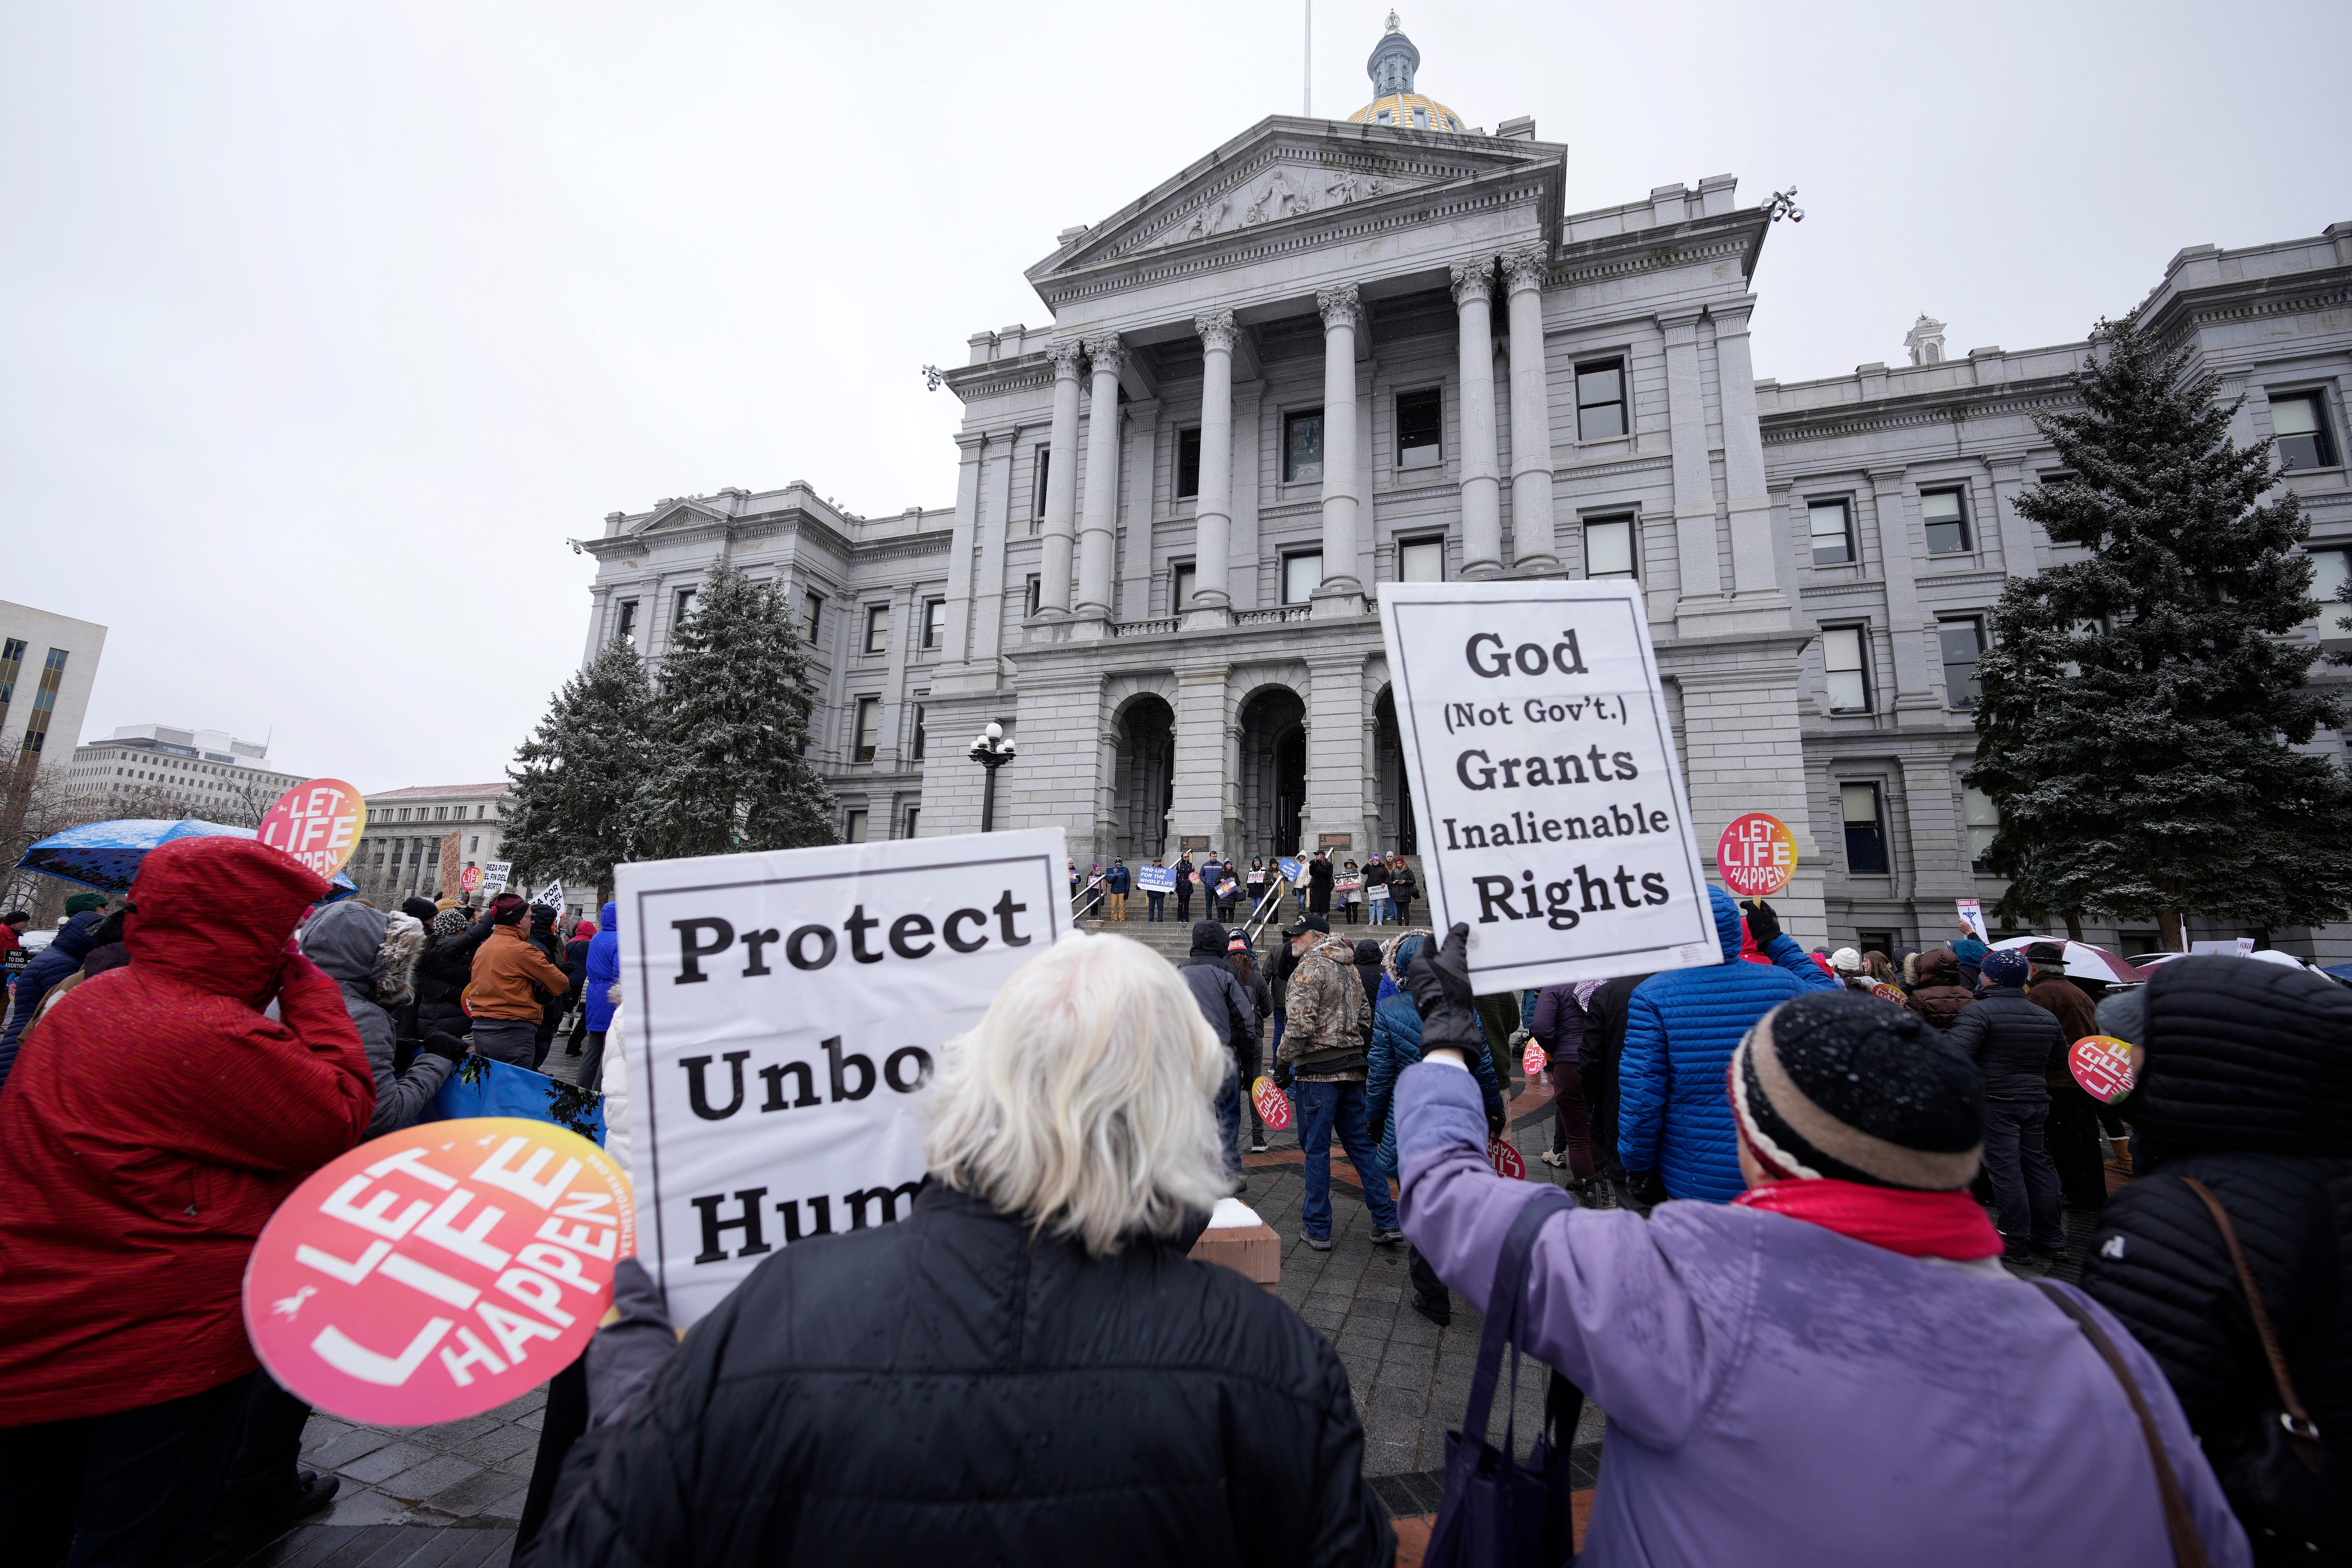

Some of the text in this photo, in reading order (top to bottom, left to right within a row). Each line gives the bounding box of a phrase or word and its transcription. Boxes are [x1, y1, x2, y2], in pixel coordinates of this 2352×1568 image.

[1465, 629, 1589, 678] God
[1444, 695, 1627, 734] (Not Gov't.)
[1457, 745, 1638, 791] Grants
[289, 787, 345, 819] LET
[264, 816, 357, 852] LIFE
[1443, 803, 1670, 851] Inalienable
[1739, 820, 1775, 842] LET
[1283, 864, 1296, 873] Abortions
[1724, 842, 1791, 866] LIFE
[544, 884, 559, 900] POR
[1730, 866, 1785, 890] HAPPEN
[1766, 863, 1795, 893] SAVETHESTORKS.ORG
[550, 892, 562, 907] DEL
[1472, 864, 1669, 930] Rights
[671, 890, 1032, 985] Protect
[1876, 987, 1888, 1001] ET
[1537, 1047, 1545, 1068] HAPP
[2076, 1042, 2105, 1073] LET
[2085, 1043, 2132, 1095] LIFE
[678, 1035, 934, 1121] Unbo
[1255, 1082, 1287, 1124] LIFE
[1257, 1100, 1276, 1123] LET
[1264, 1080, 1287, 1111] HAPPEN
[1487, 1139, 1515, 1160] HAPP
[295, 1147, 459, 1286] LET
[691, 1180, 925, 1265] Hum
[310, 1137, 583, 1387] LIFE
[438, 1191, 618, 1387] HAPPEN
